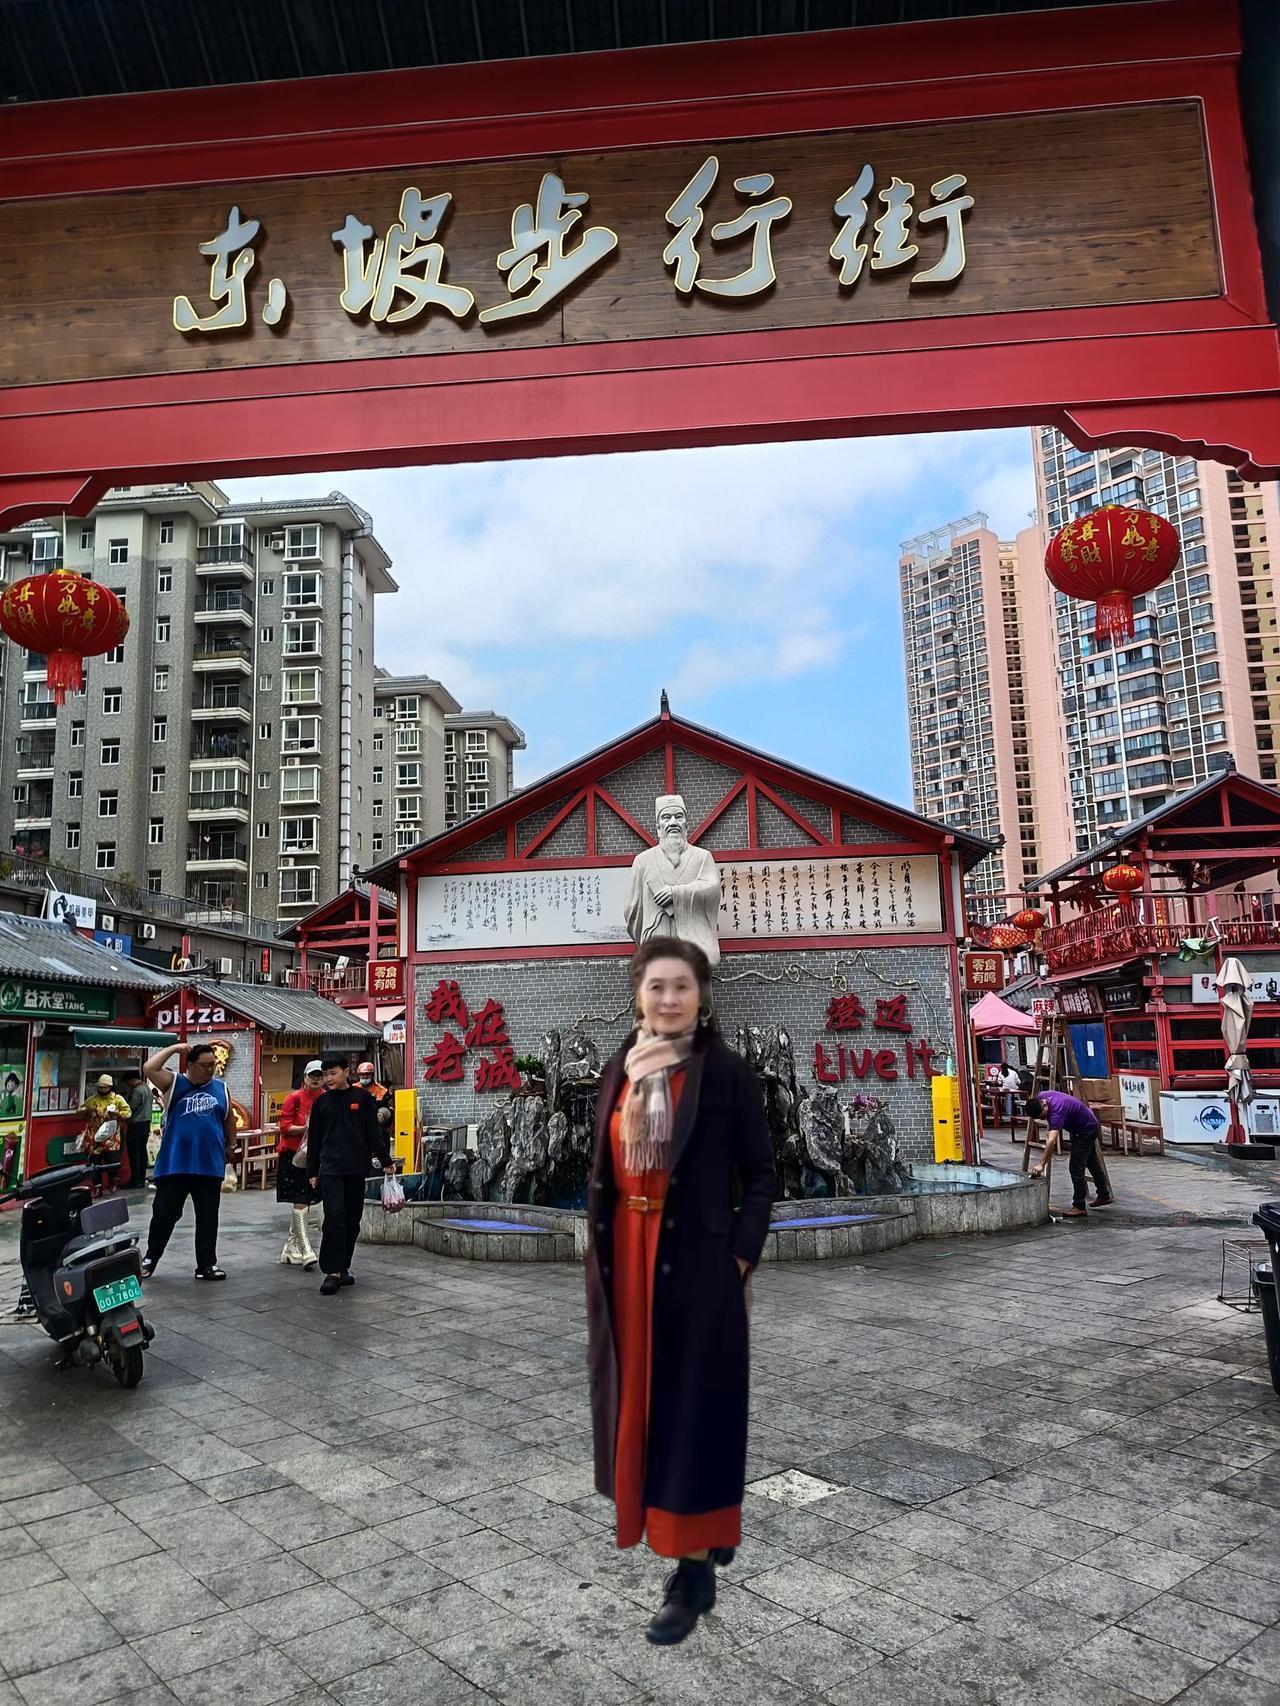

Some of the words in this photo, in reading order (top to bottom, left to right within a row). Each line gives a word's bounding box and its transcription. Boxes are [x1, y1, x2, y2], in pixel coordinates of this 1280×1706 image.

[172, 154, 976, 333] 东坡步行街
[374, 966, 397, 978] 零食
[972, 958, 997, 970] 零食
[23, 988, 64, 1010] 益禾堂
[65, 1001, 85, 1011] TANG
[157, 1004, 226, 1030] pizza
[424, 980, 510, 1049] 我在
[825, 992, 912, 1034] 澄迈
[423, 1031, 521, 1092] 老城
[99, 1287, 140, 1309] 0017806
